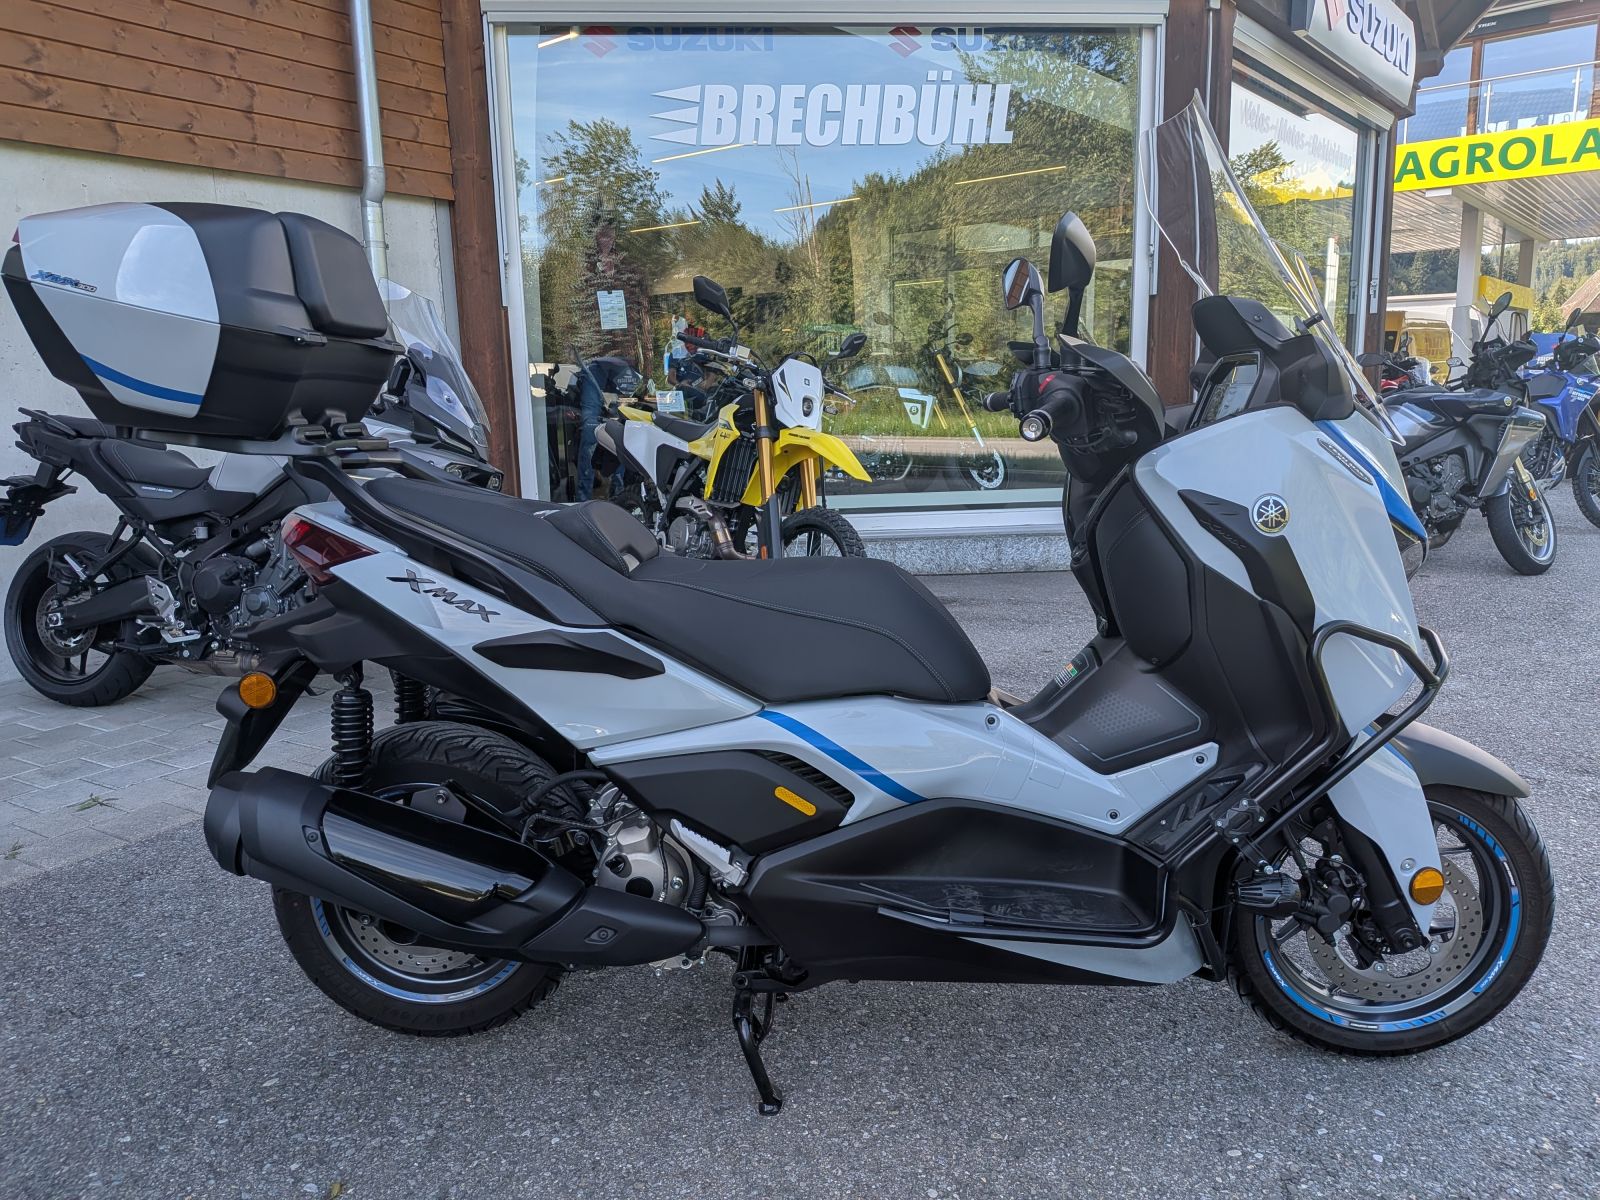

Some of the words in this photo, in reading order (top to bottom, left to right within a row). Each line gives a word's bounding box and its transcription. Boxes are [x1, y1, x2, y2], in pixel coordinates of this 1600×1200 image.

[626, 26, 774, 51] SUZUKI
[1346, 0, 1411, 76] SUZUKI
[700, 70, 1014, 147] BRECHBÜHL
[1394, 127, 1600, 184] AGROLA
